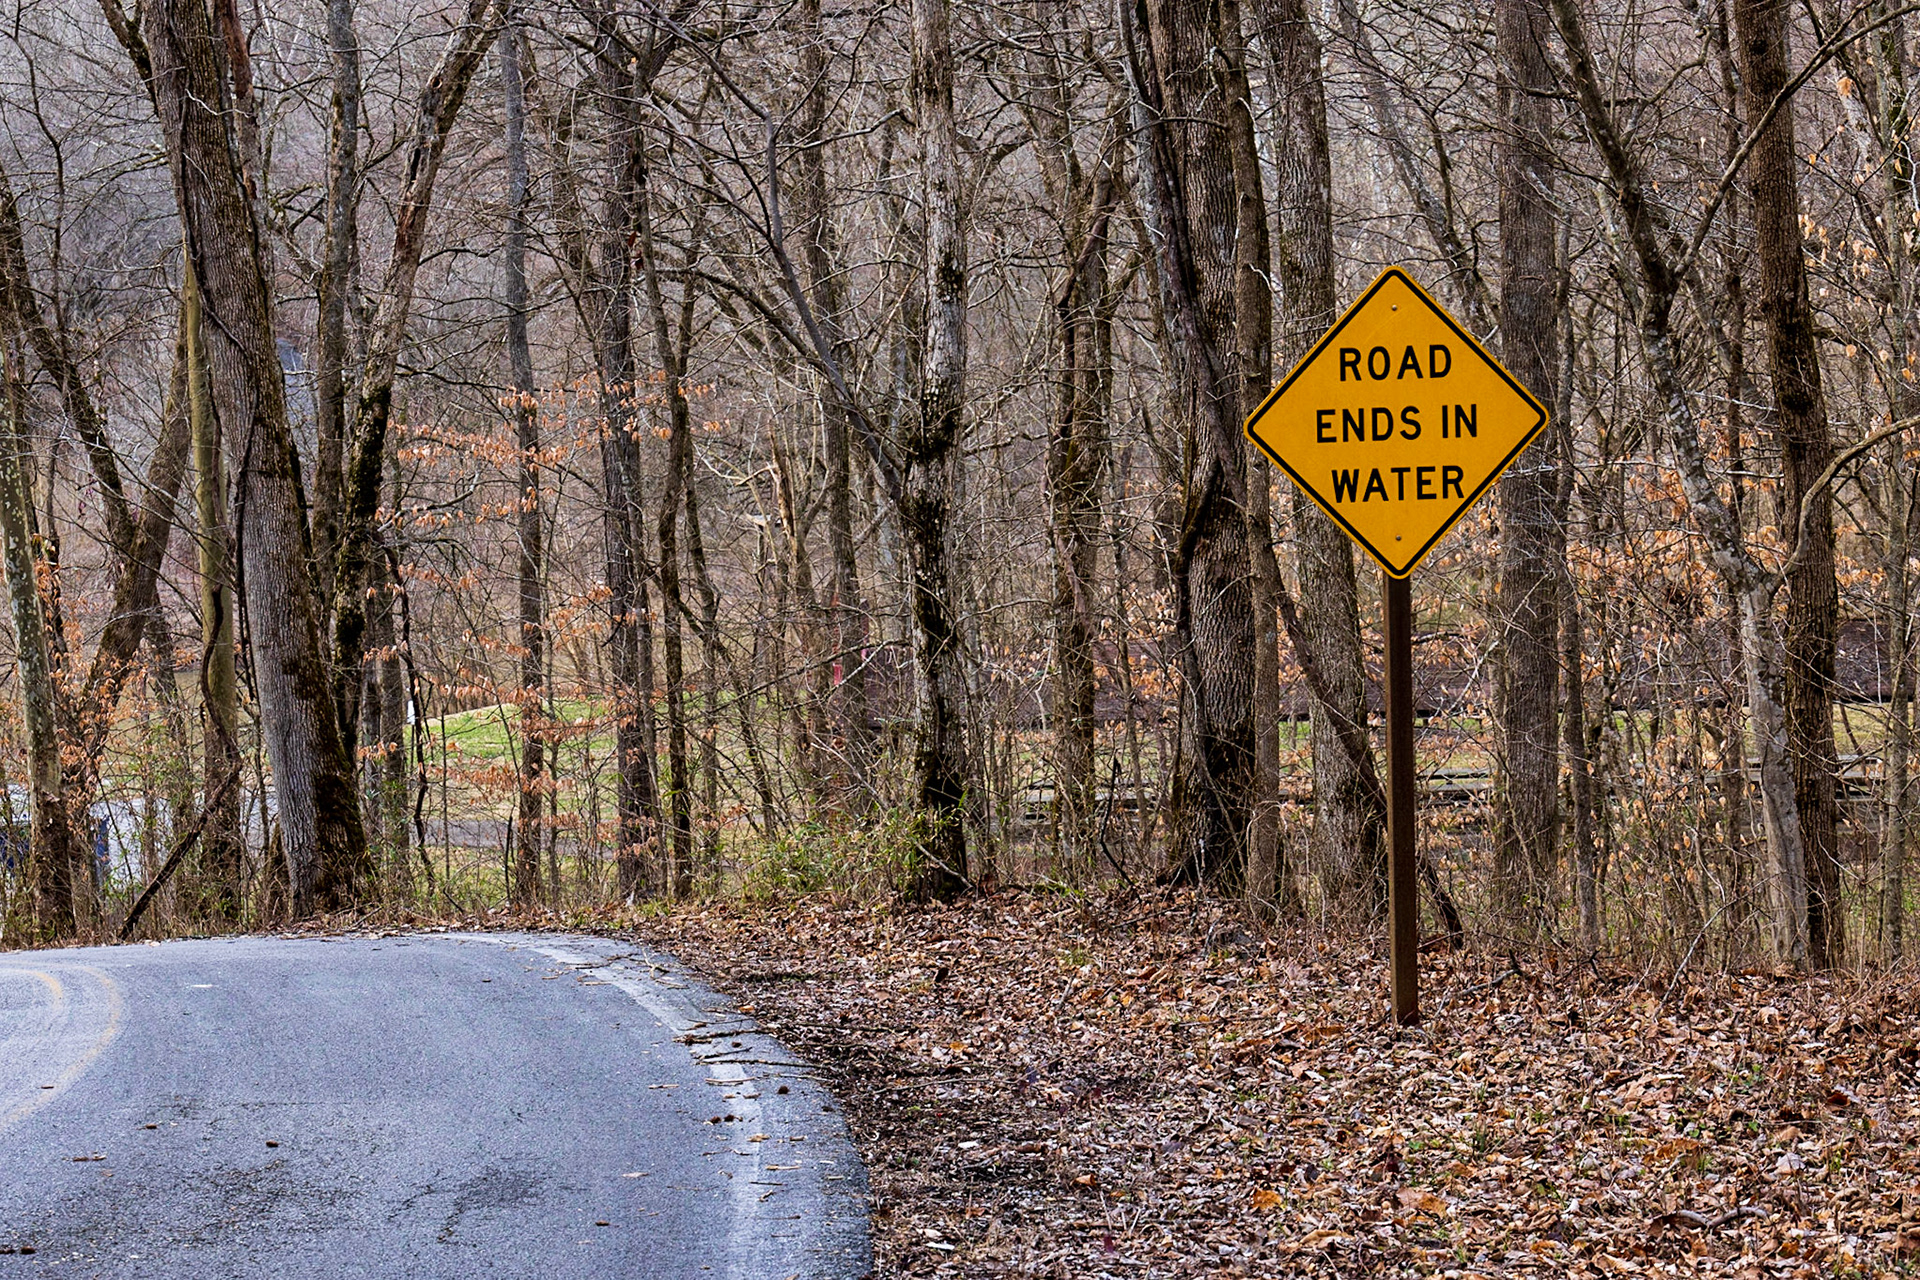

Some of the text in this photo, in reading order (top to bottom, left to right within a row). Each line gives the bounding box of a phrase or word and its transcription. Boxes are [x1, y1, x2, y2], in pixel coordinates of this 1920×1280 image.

[1339, 344, 1452, 382] ROAD
[1316, 403, 1478, 443] ENDS IN
[1331, 465, 1465, 504] WATER
